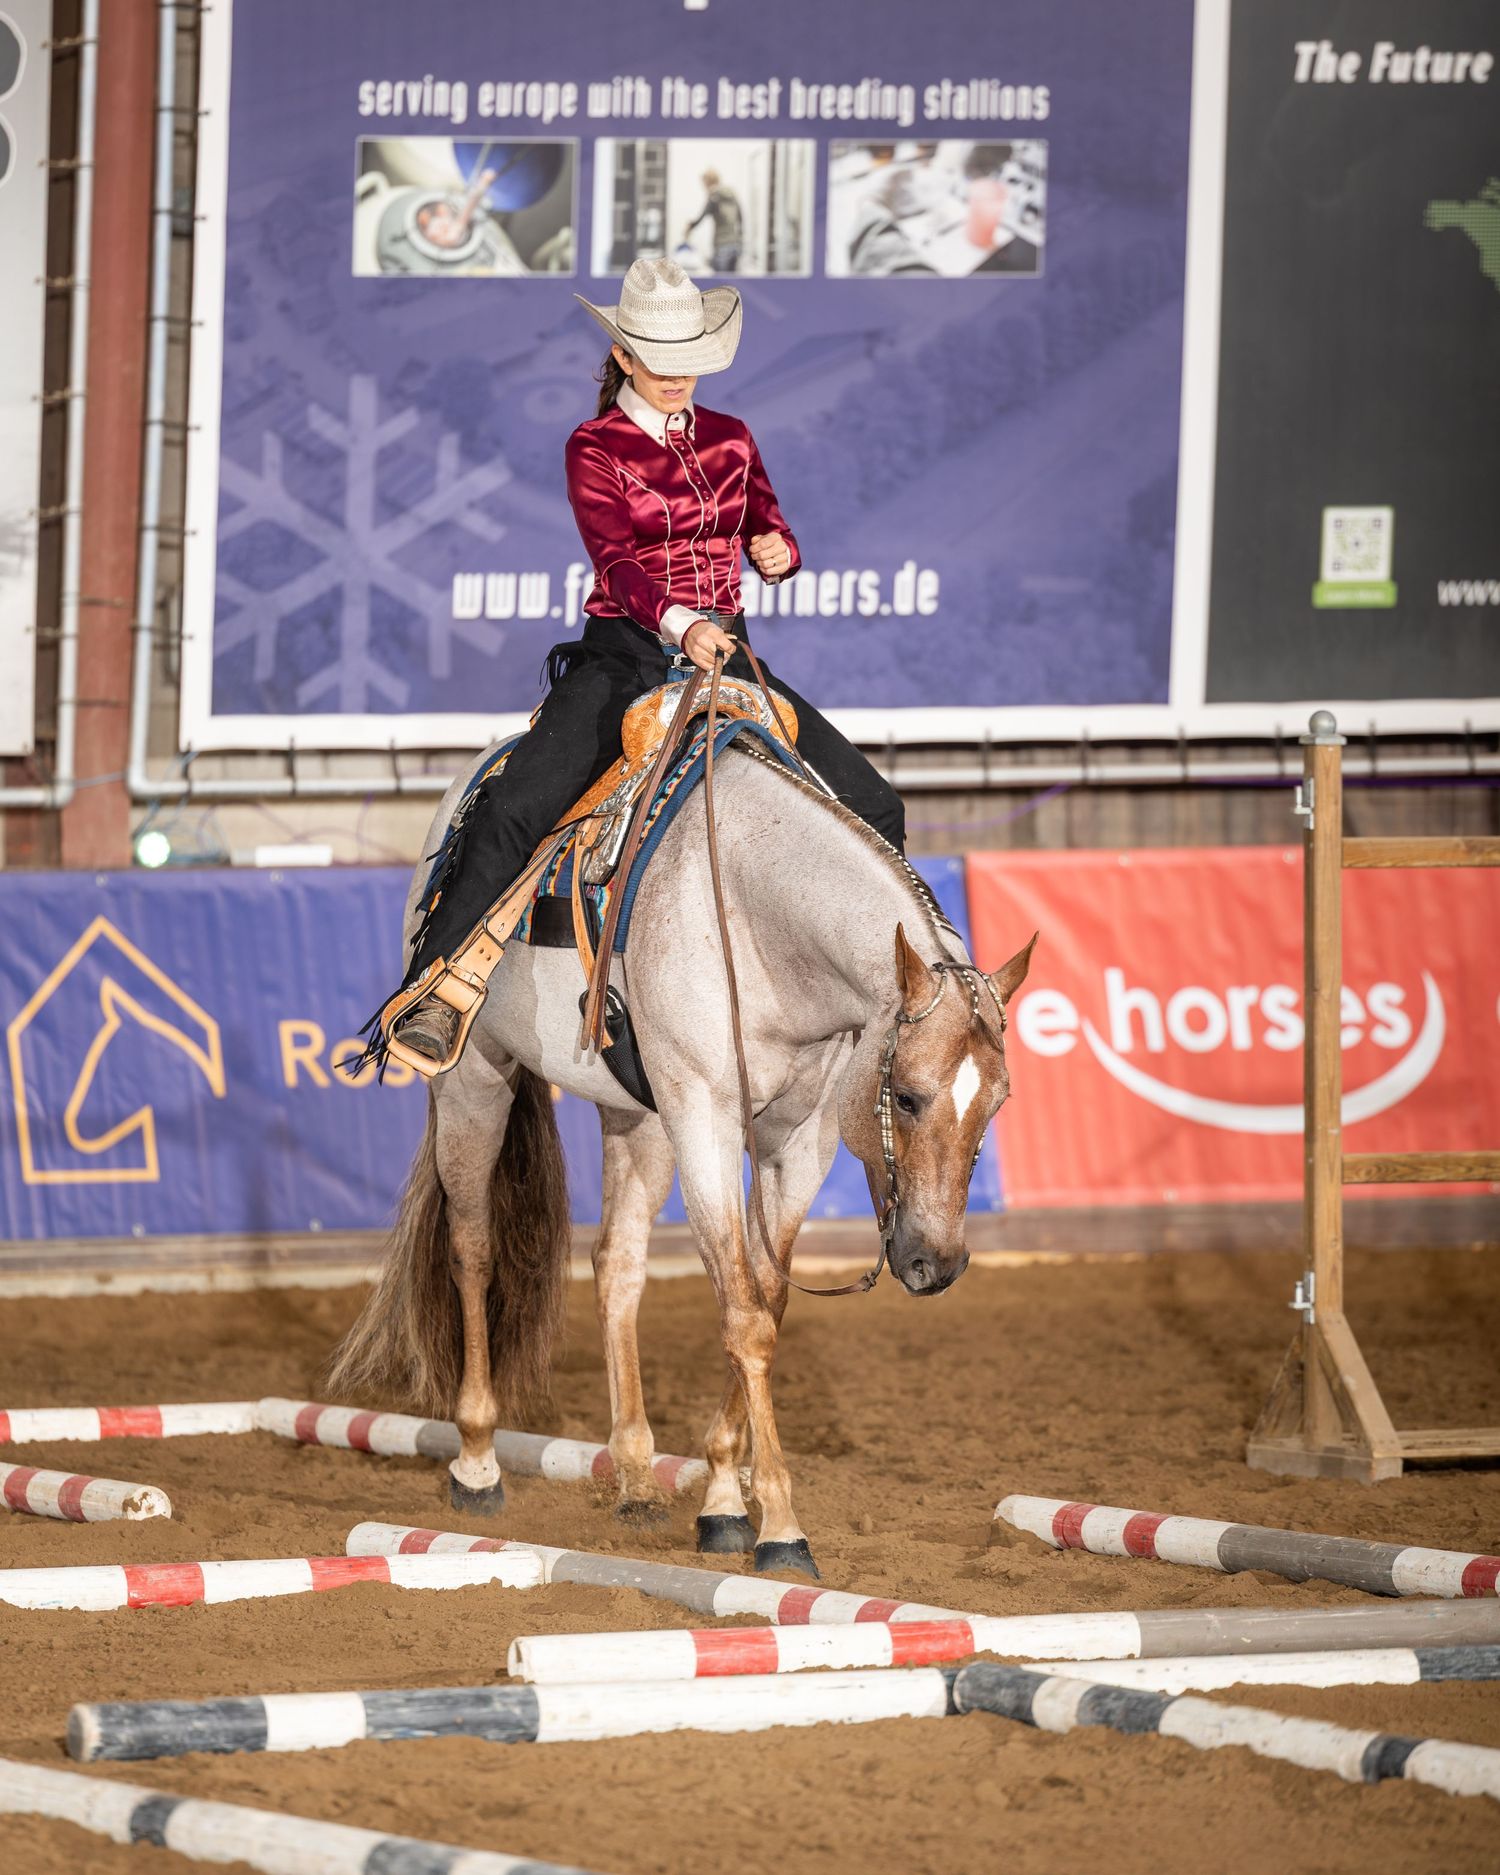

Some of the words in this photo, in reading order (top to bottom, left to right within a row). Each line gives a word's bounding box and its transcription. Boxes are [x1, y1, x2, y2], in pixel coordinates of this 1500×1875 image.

[1294, 40, 1361, 83] The
[1368, 41, 1494, 83] Future
[358, 74, 468, 124] serving
[478, 81, 578, 124] europe
[587, 76, 652, 118] with
[661, 76, 708, 119] the
[717, 77, 782, 119] best
[789, 77, 915, 127] breeding
[923, 78, 1050, 120] stallions
